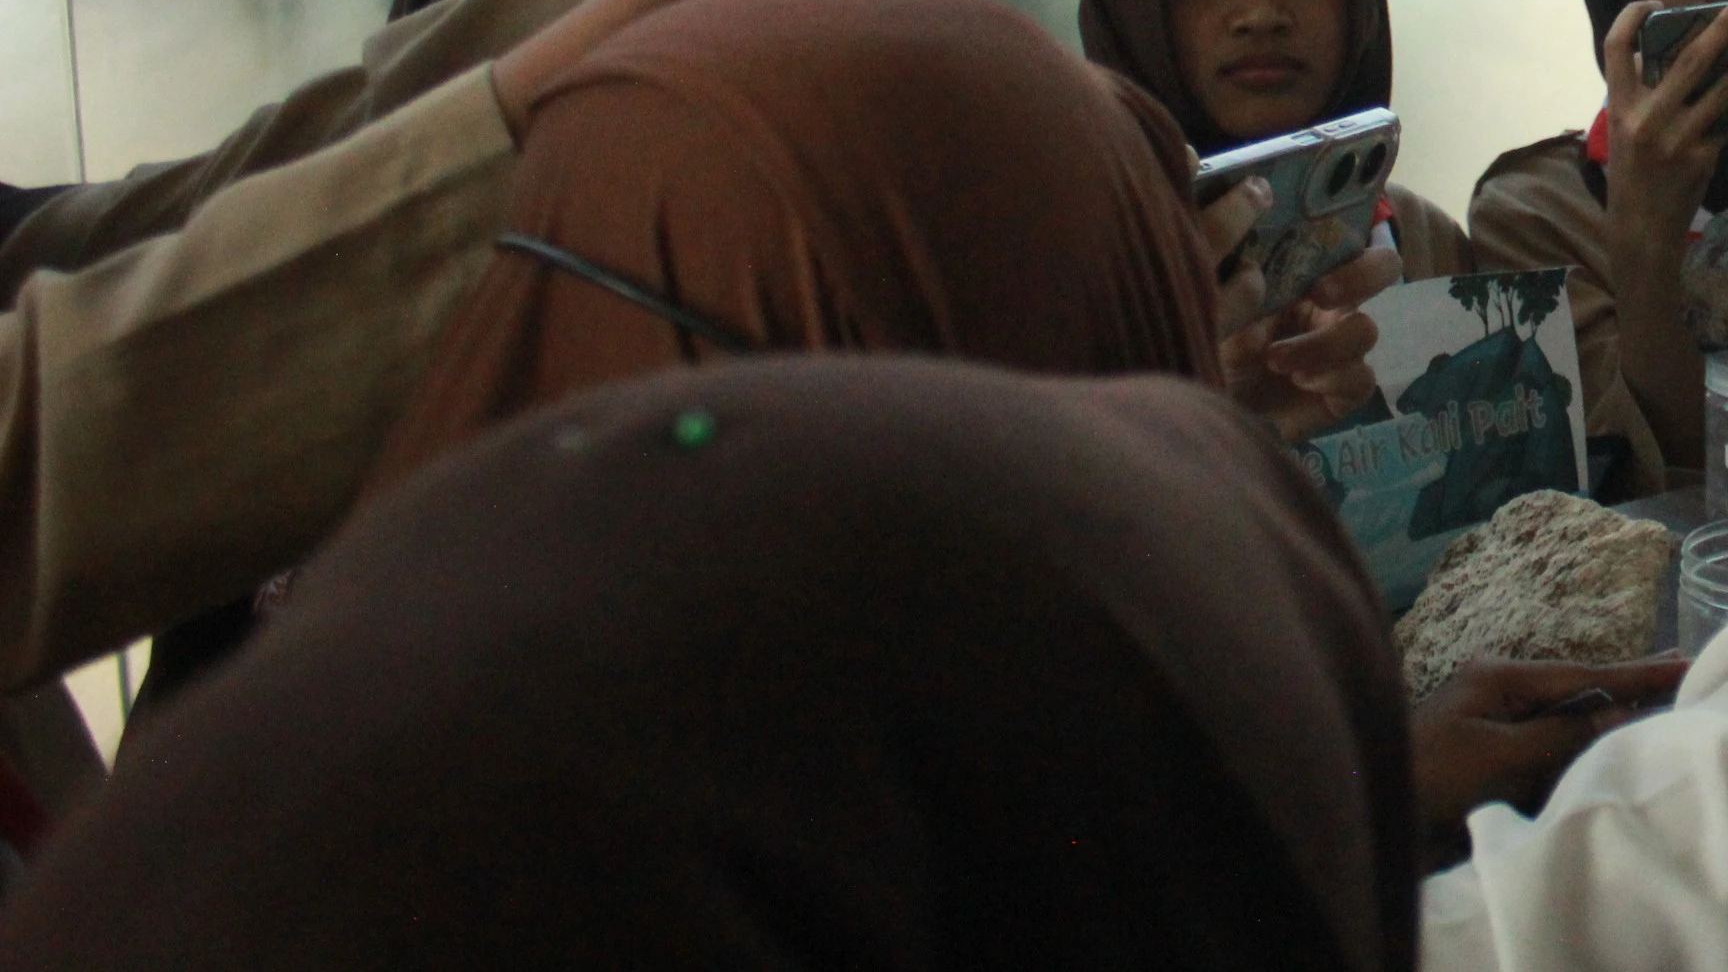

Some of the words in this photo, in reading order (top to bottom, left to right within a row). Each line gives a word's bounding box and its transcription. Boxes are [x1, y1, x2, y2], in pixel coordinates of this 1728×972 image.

[1335, 423, 1385, 482] Air
[1398, 399, 1462, 460] Kali
[1467, 383, 1547, 445] Pait
